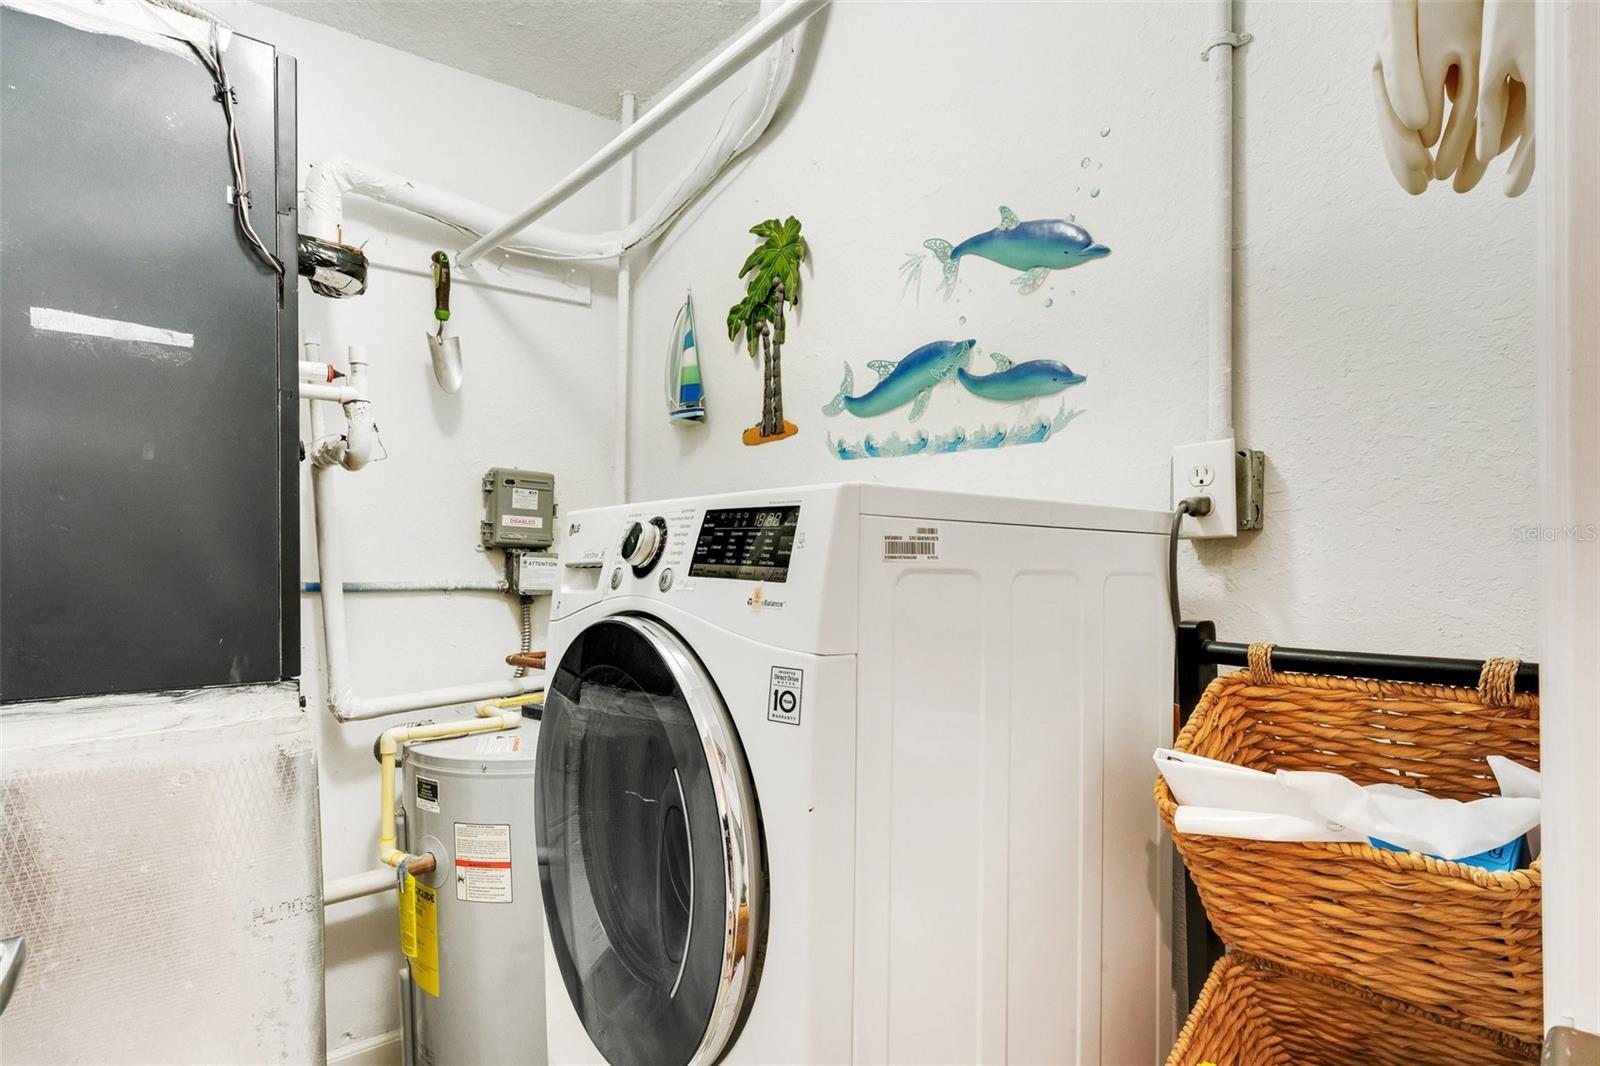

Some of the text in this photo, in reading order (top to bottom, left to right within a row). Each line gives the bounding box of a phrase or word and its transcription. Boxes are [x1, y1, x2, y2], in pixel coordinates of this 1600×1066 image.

[569, 523, 581, 536] LG
[774, 673, 800, 683] Direct Drive
[773, 688, 797, 714] 10
